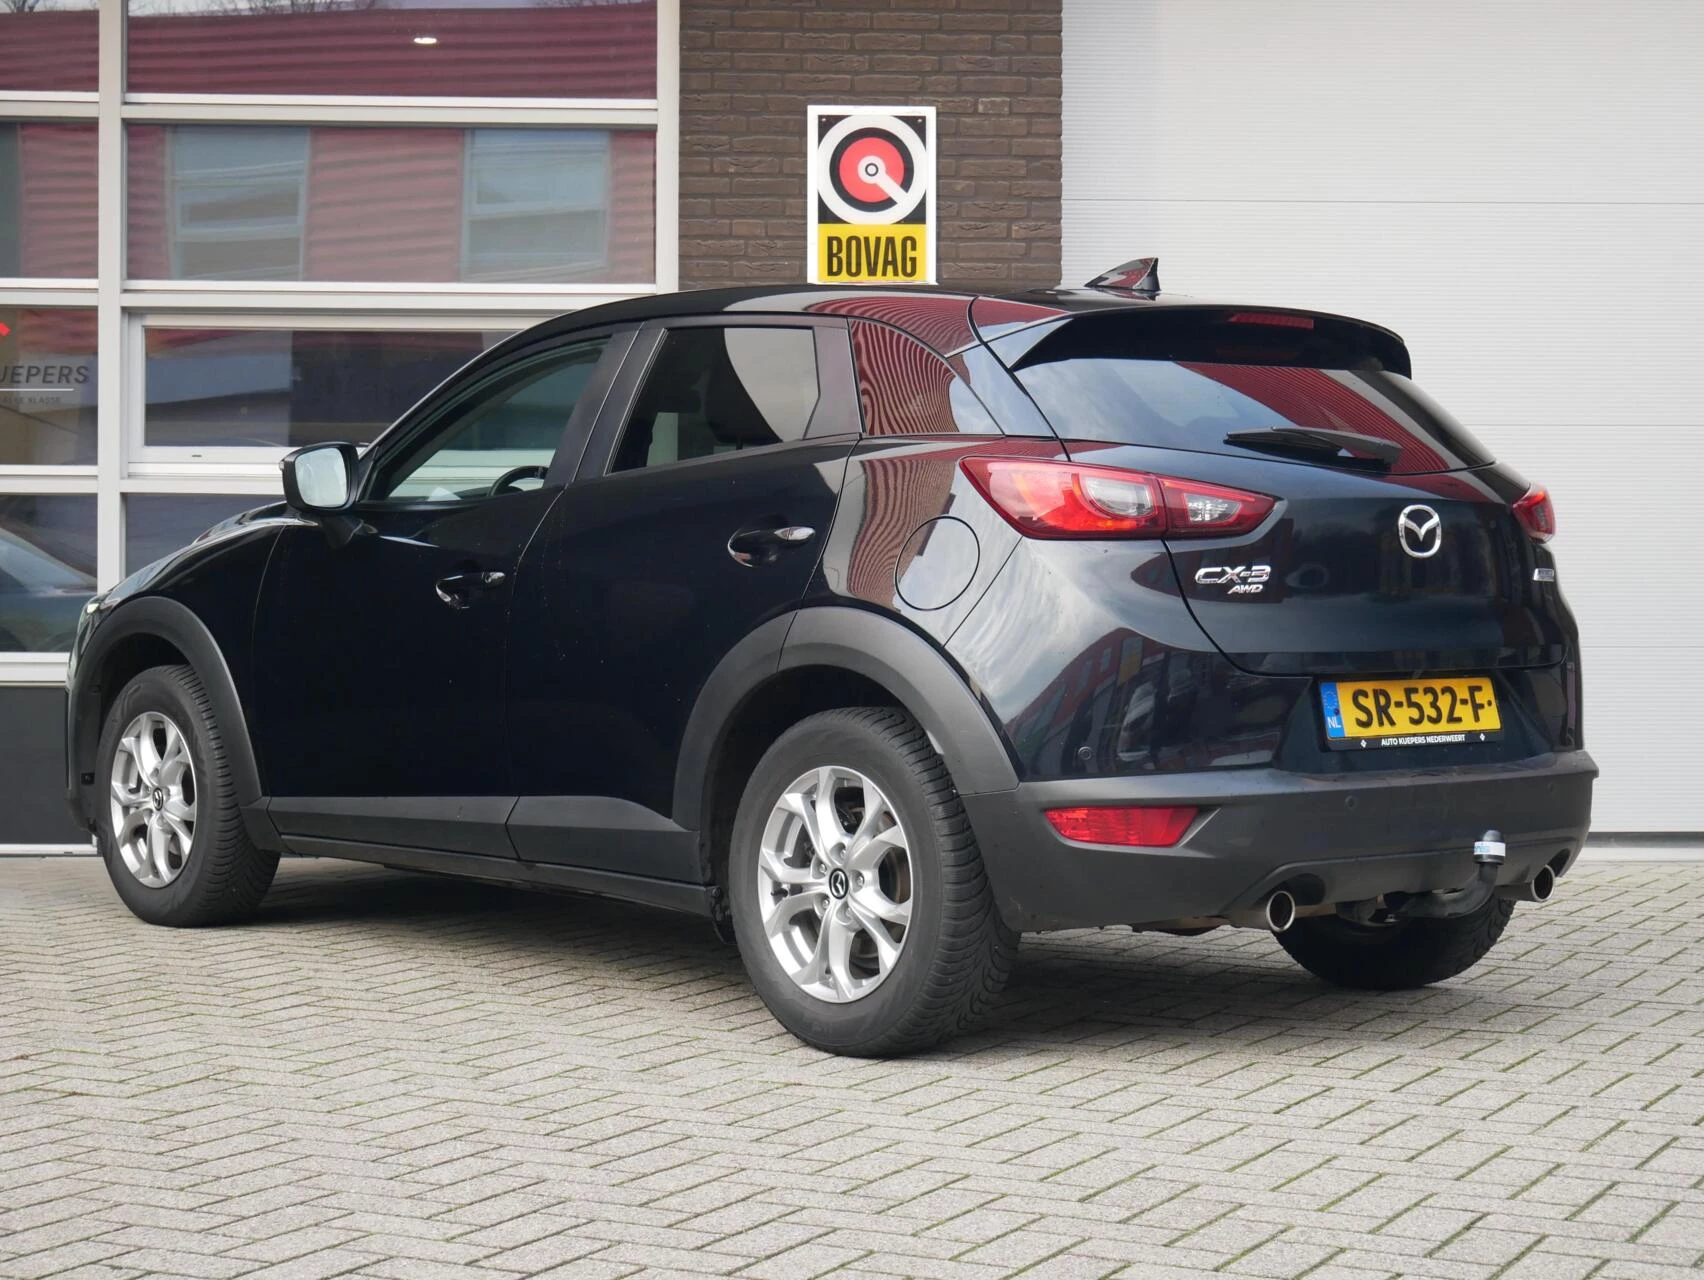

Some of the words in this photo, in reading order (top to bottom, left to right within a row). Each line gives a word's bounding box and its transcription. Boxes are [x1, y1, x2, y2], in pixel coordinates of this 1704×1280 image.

[827, 235, 917, 278] BOVAG
[1195, 565, 1271, 584] CX-3
[1227, 584, 1263, 594] AWD
[1328, 716, 1342, 729] NL
[1381, 738, 1398, 746] AUTO
[1399, 736, 1426, 745] KUEPERS
[1426, 733, 1466, 743] NEDERWEERT
